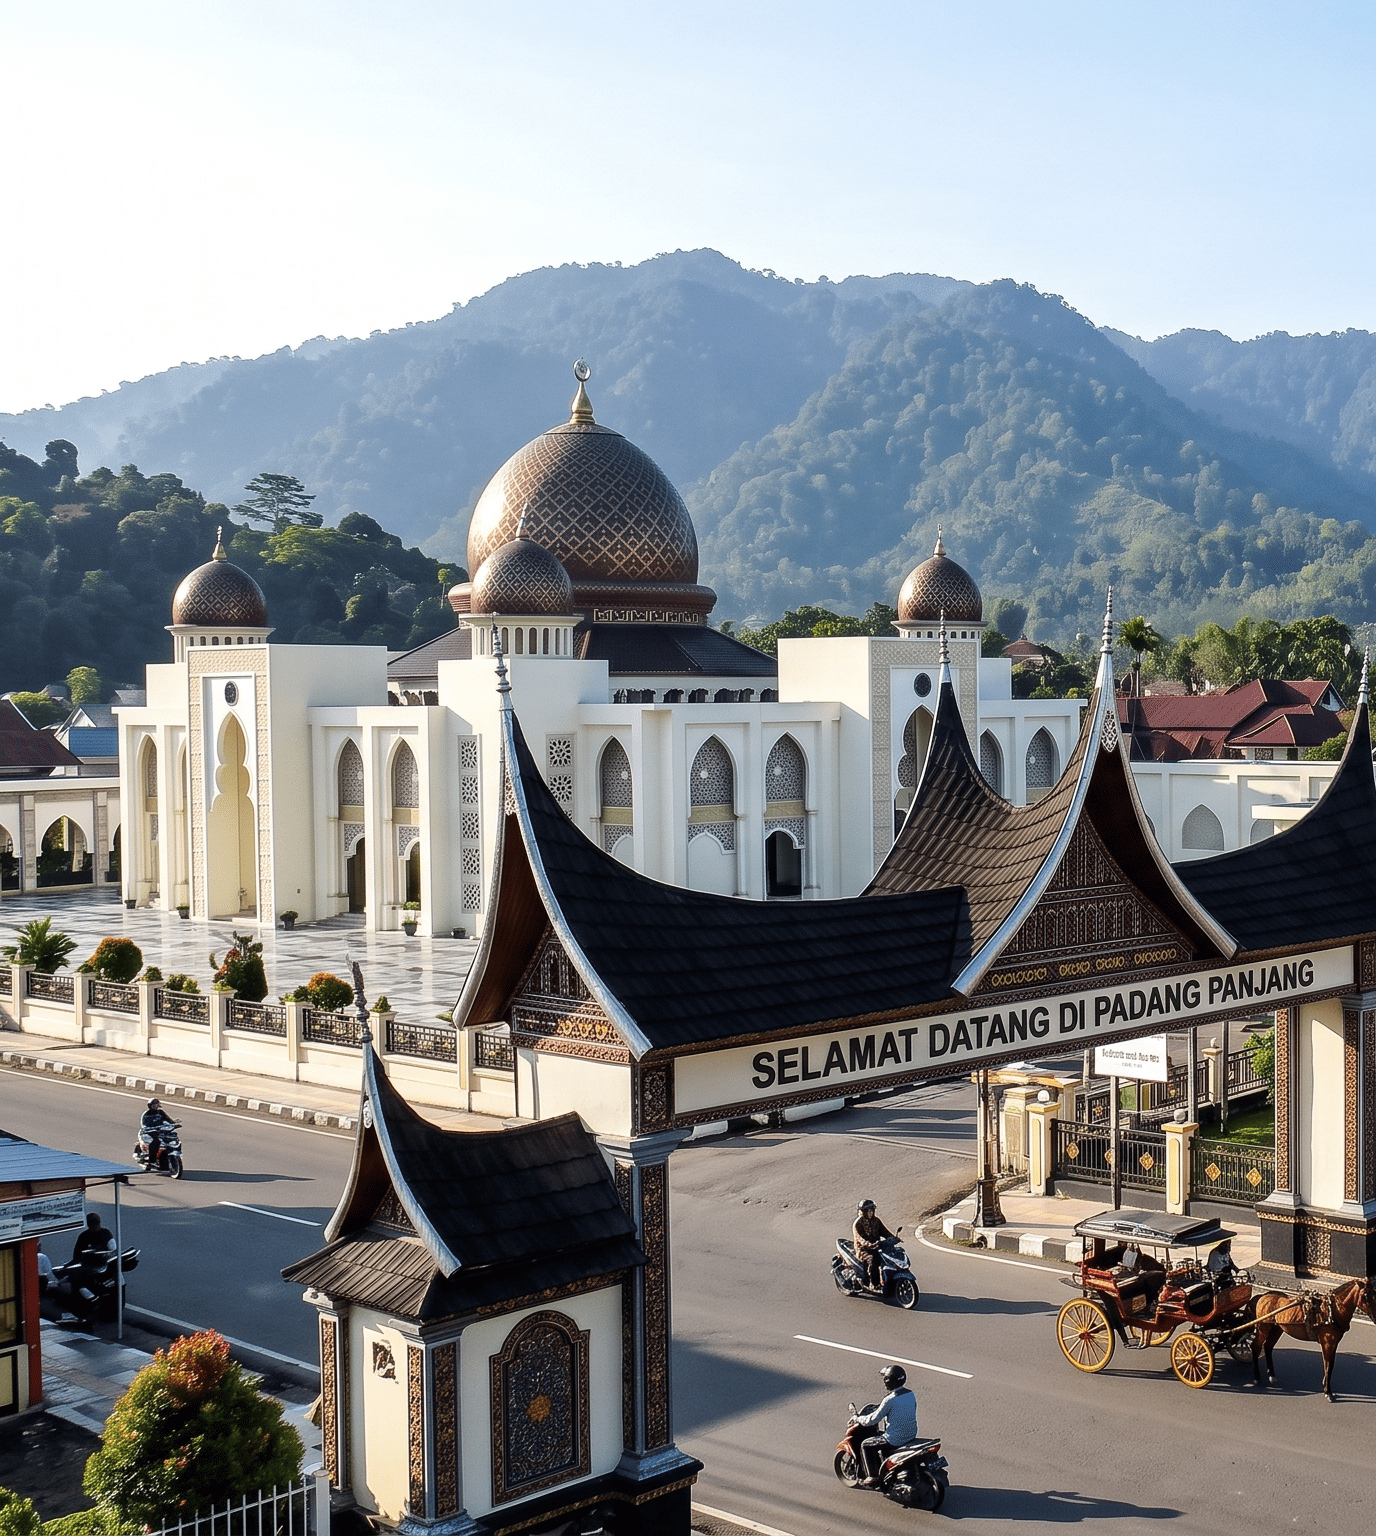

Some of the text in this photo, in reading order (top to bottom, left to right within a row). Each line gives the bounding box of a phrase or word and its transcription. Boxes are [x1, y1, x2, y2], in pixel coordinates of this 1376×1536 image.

[752, 959, 1314, 1088] SELAMAT DATANG DI PADANG PANJANG
